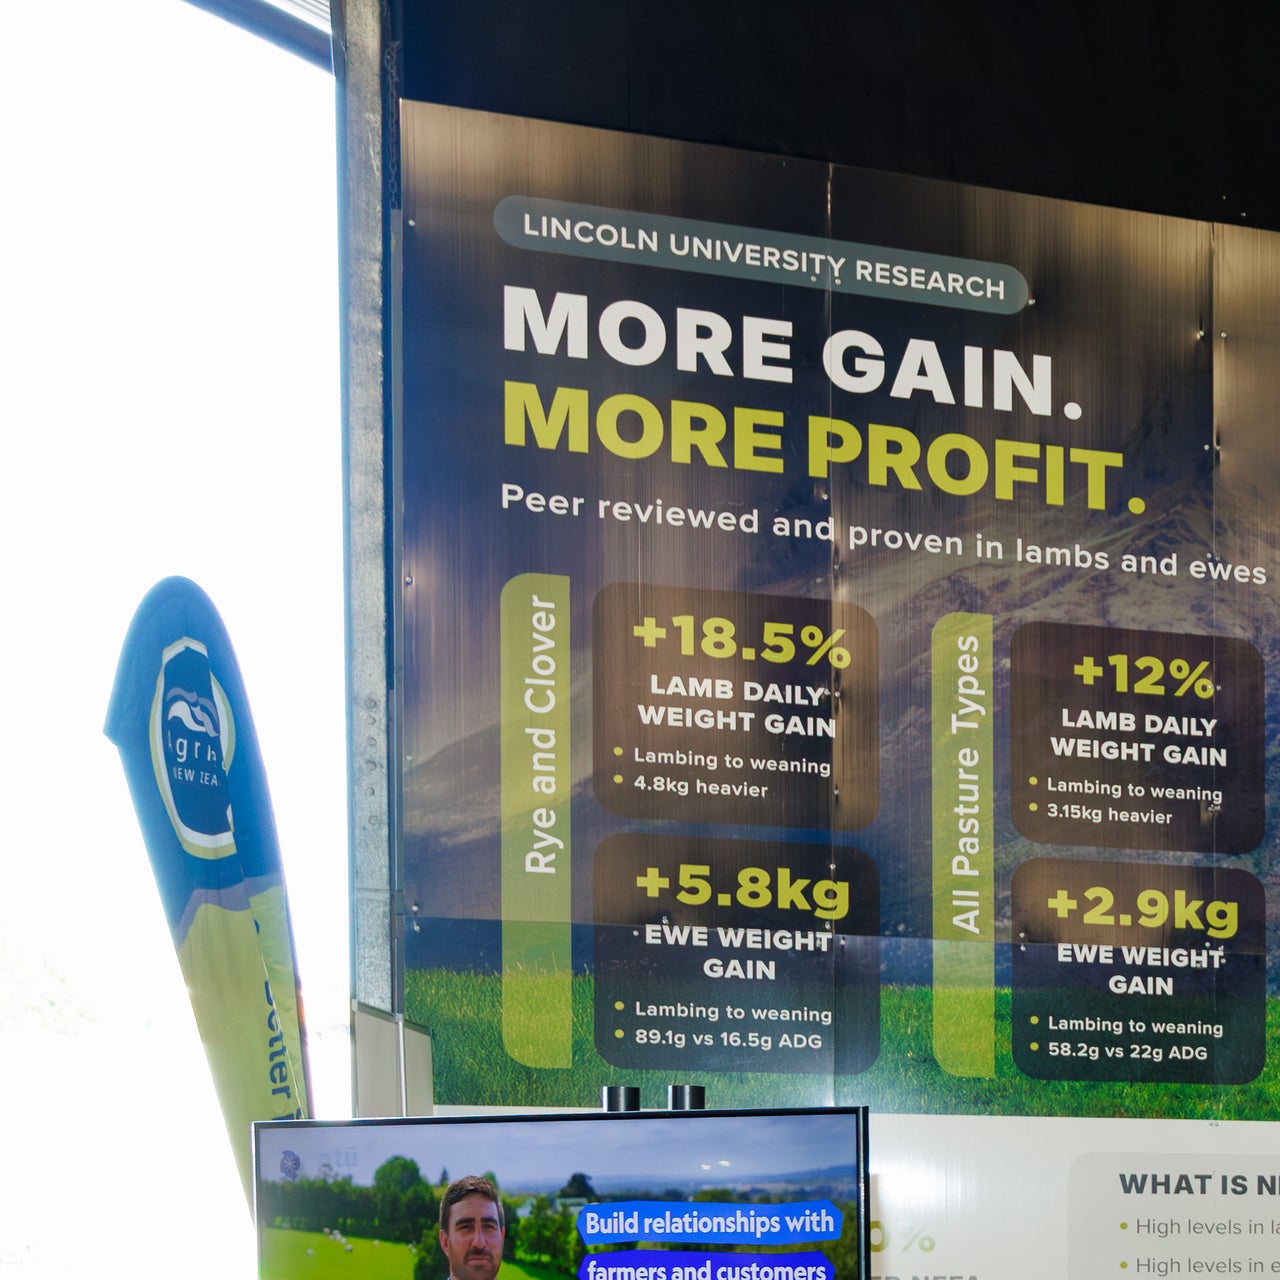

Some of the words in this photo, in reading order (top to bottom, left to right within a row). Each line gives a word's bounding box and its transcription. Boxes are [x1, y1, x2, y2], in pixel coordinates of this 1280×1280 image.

[522, 212, 659, 253] LINCOLN
[669, 233, 845, 278] UNIVERSITY
[856, 259, 1005, 301] RESEARCH
[503, 284, 795, 384] MORE
[823, 327, 1083, 421] GAIN.
[503, 380, 784, 473] MORE
[807, 414, 1146, 514] PROFIT.
[501, 483, 584, 517] Peer
[598, 495, 759, 535] reviewed
[771, 509, 835, 541] and
[848, 523, 963, 558] proven
[975, 531, 1004, 559] in
[1016, 537, 1110, 572] lambs
[1119, 548, 1178, 576] and
[1187, 559, 1267, 586] ewes
[524, 594, 559, 715] Clover
[633, 613, 852, 670] +18.5%
[650, 674, 734, 700] LAMB
[743, 680, 825, 706] DAILY
[951, 634, 986, 734] Types
[1073, 653, 1214, 700] +12%
[638, 704, 755, 734] WEIGHT
[764, 713, 837, 738] GAIN
[1060, 708, 1136, 733] LAMB
[1145, 713, 1217, 737] DAILY
[525, 729, 557, 796] and
[634, 748, 717, 773] Lambing
[725, 753, 744, 770] to
[750, 755, 832, 777] weaning
[1050, 734, 1156, 762] WEIGHT
[1162, 742, 1227, 767] GAIN
[634, 774, 689, 798] 4.8kg
[695, 777, 768, 799] heavier
[951, 747, 982, 875] Pasture
[524, 805, 563, 875] Rye
[636, 863, 851, 920] +5.8kg
[952, 888, 981, 935] All
[1046, 886, 1239, 940] +2.9kg
[645, 923, 709, 949] EWE
[718, 928, 832, 952] WEIGHT
[1057, 943, 1114, 966] EWE
[1121, 945, 1223, 970] WEIGHT
[703, 956, 776, 980] GAIN
[1108, 973, 1174, 996] GAIN
[1119, 1173, 1212, 1195] WHAT
[1221, 1174, 1248, 1196] IS
[586, 1211, 638, 1234] Build
[644, 1210, 781, 1238] relationships
[785, 1209, 834, 1233] with
[1136, 1218, 1183, 1240] High
[1187, 1218, 1243, 1236] levels
[1249, 1218, 1265, 1235] in
